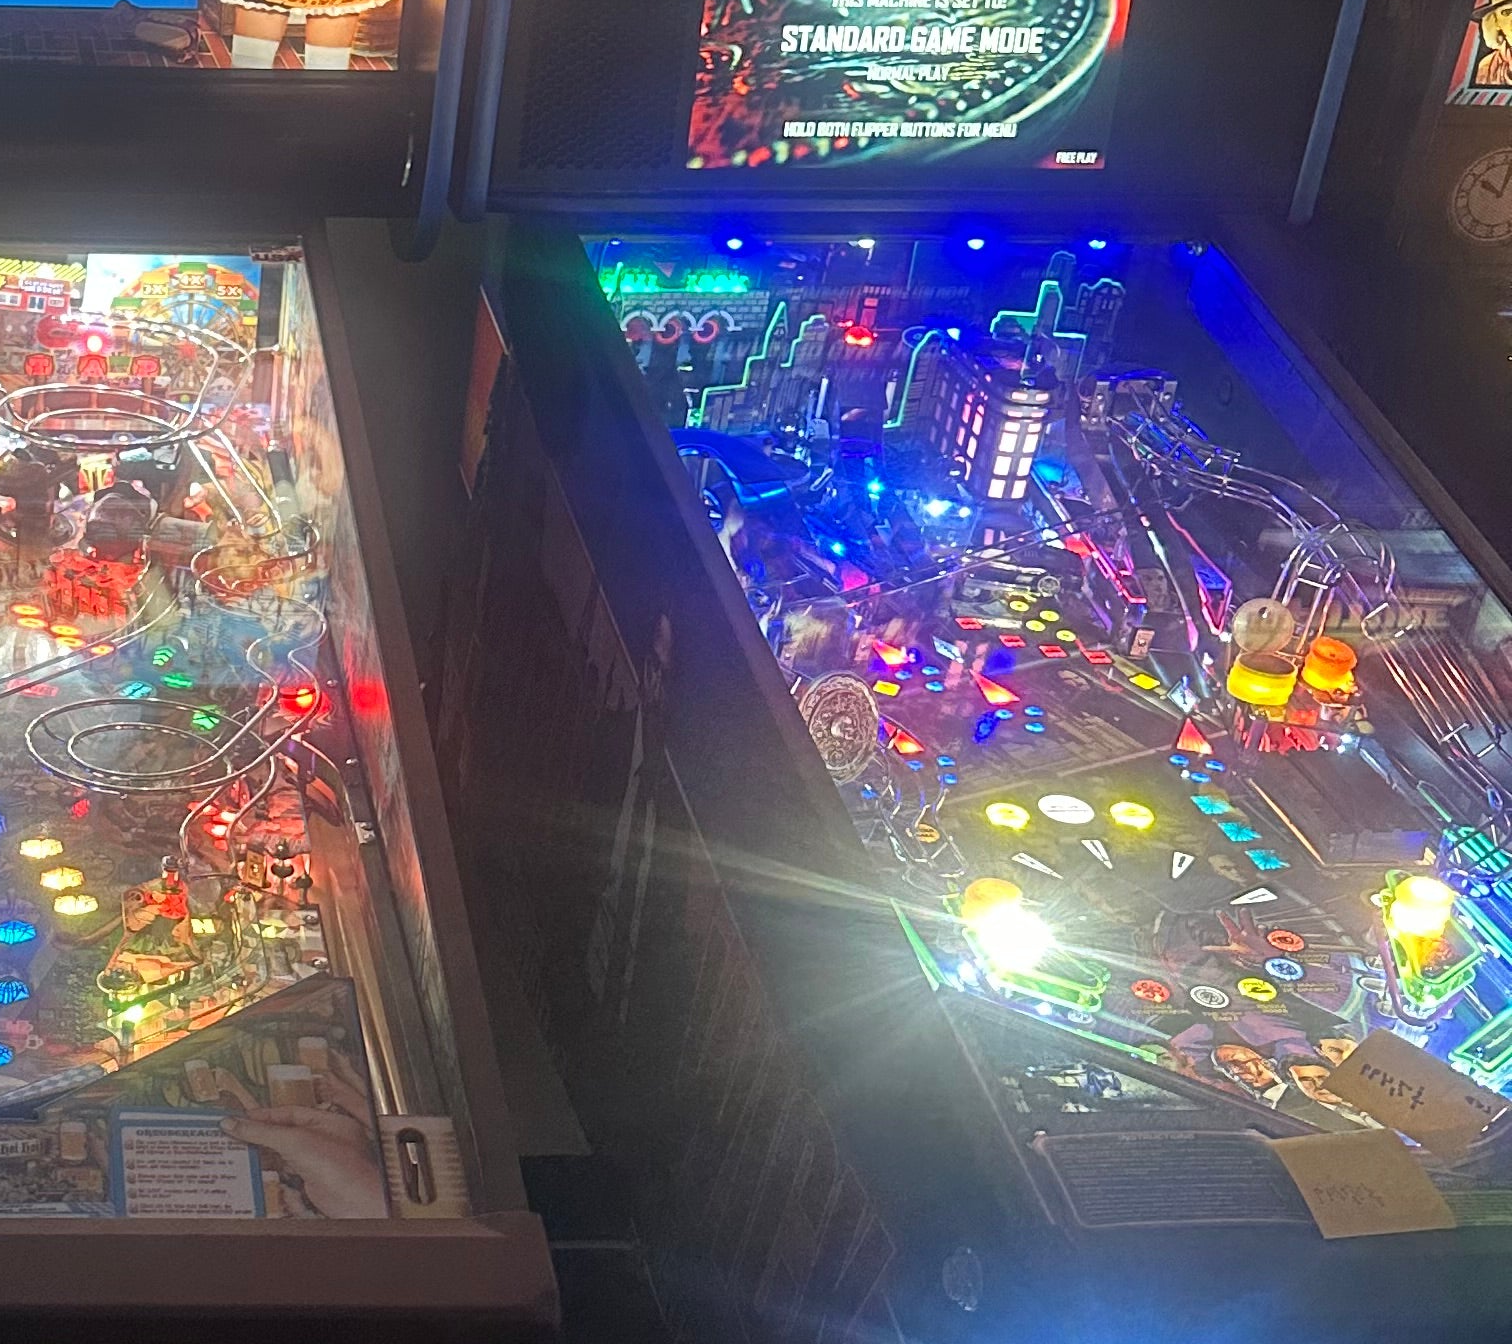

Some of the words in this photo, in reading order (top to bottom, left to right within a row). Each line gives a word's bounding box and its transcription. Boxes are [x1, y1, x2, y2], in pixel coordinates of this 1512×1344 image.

[780, 24, 906, 54] STANDARD
[910, 25, 976, 54] GAME
[978, 26, 1045, 54] MODE
[866, 63, 916, 81] NORMAL
[918, 64, 951, 82] PLAY
[783, 121, 816, 137] HOLD
[816, 121, 850, 137] BOTH
[851, 121, 898, 138] FLIPPER
[899, 122, 955, 138] BUTTONS
[956, 122, 981, 138] FOR
[982, 122, 1018, 139] MENU
[1055, 151, 1076, 164] FREE
[1076, 152, 1097, 165] PLAY
